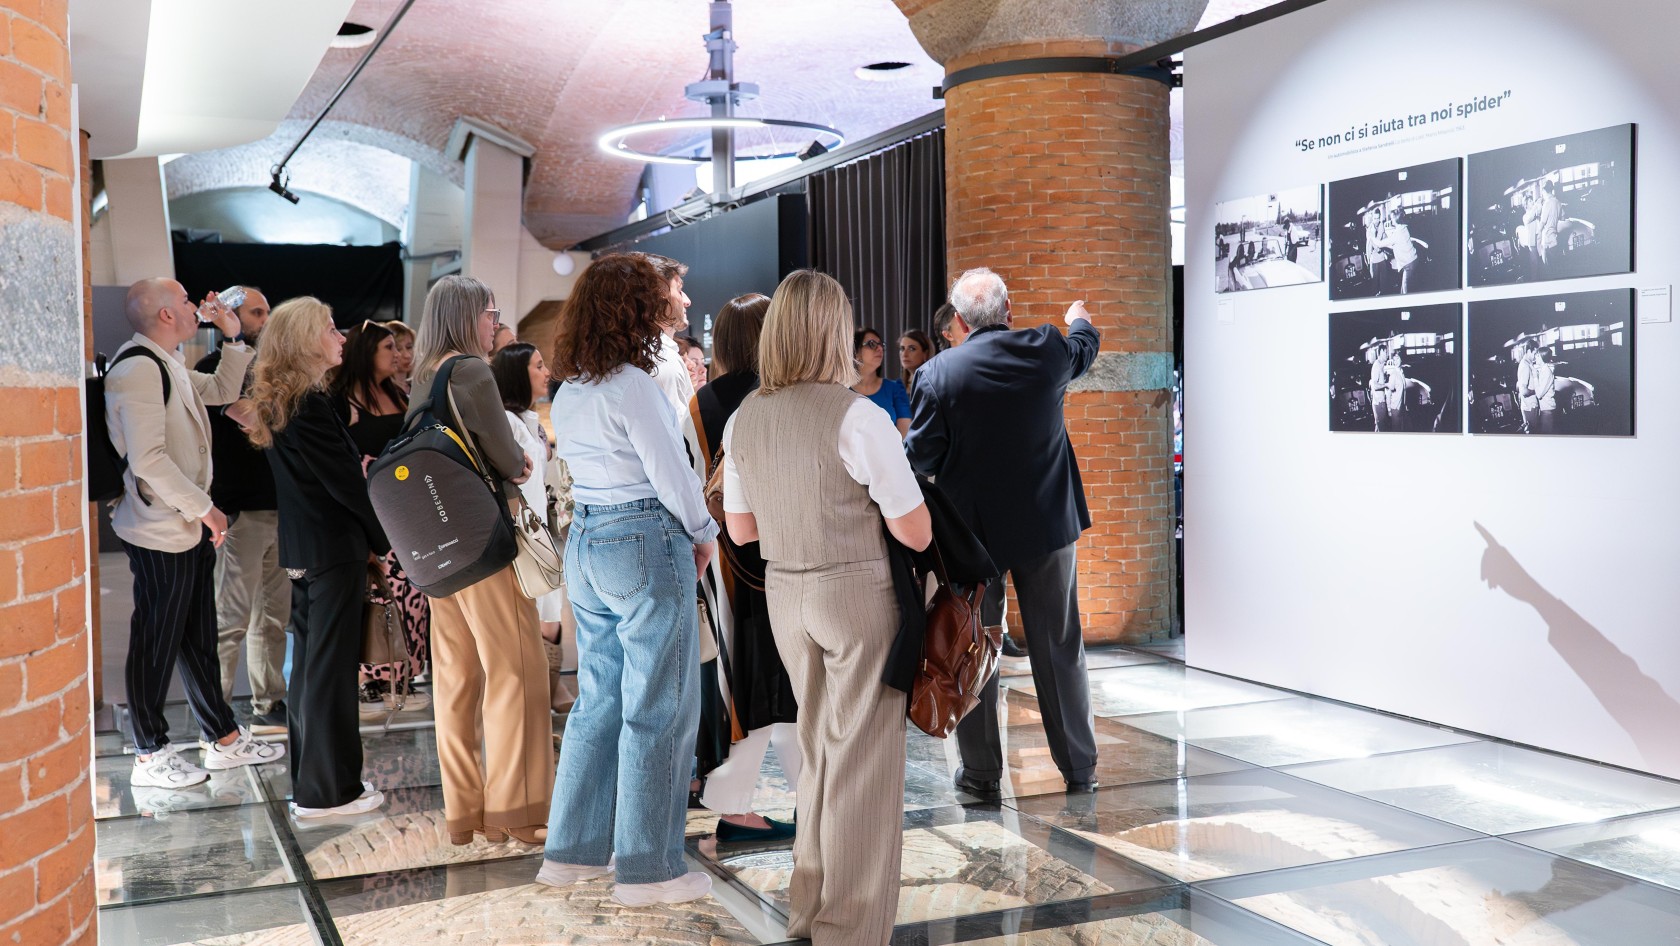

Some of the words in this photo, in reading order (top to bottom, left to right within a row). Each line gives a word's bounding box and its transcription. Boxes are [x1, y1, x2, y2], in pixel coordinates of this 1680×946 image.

[1318, 134, 1341, 148] non
[1344, 126, 1355, 142] ci
[1358, 123, 1368, 139] si
[1371, 118, 1404, 137] aiuta
[1407, 113, 1427, 127] tra
[1430, 102, 1453, 123] noi
